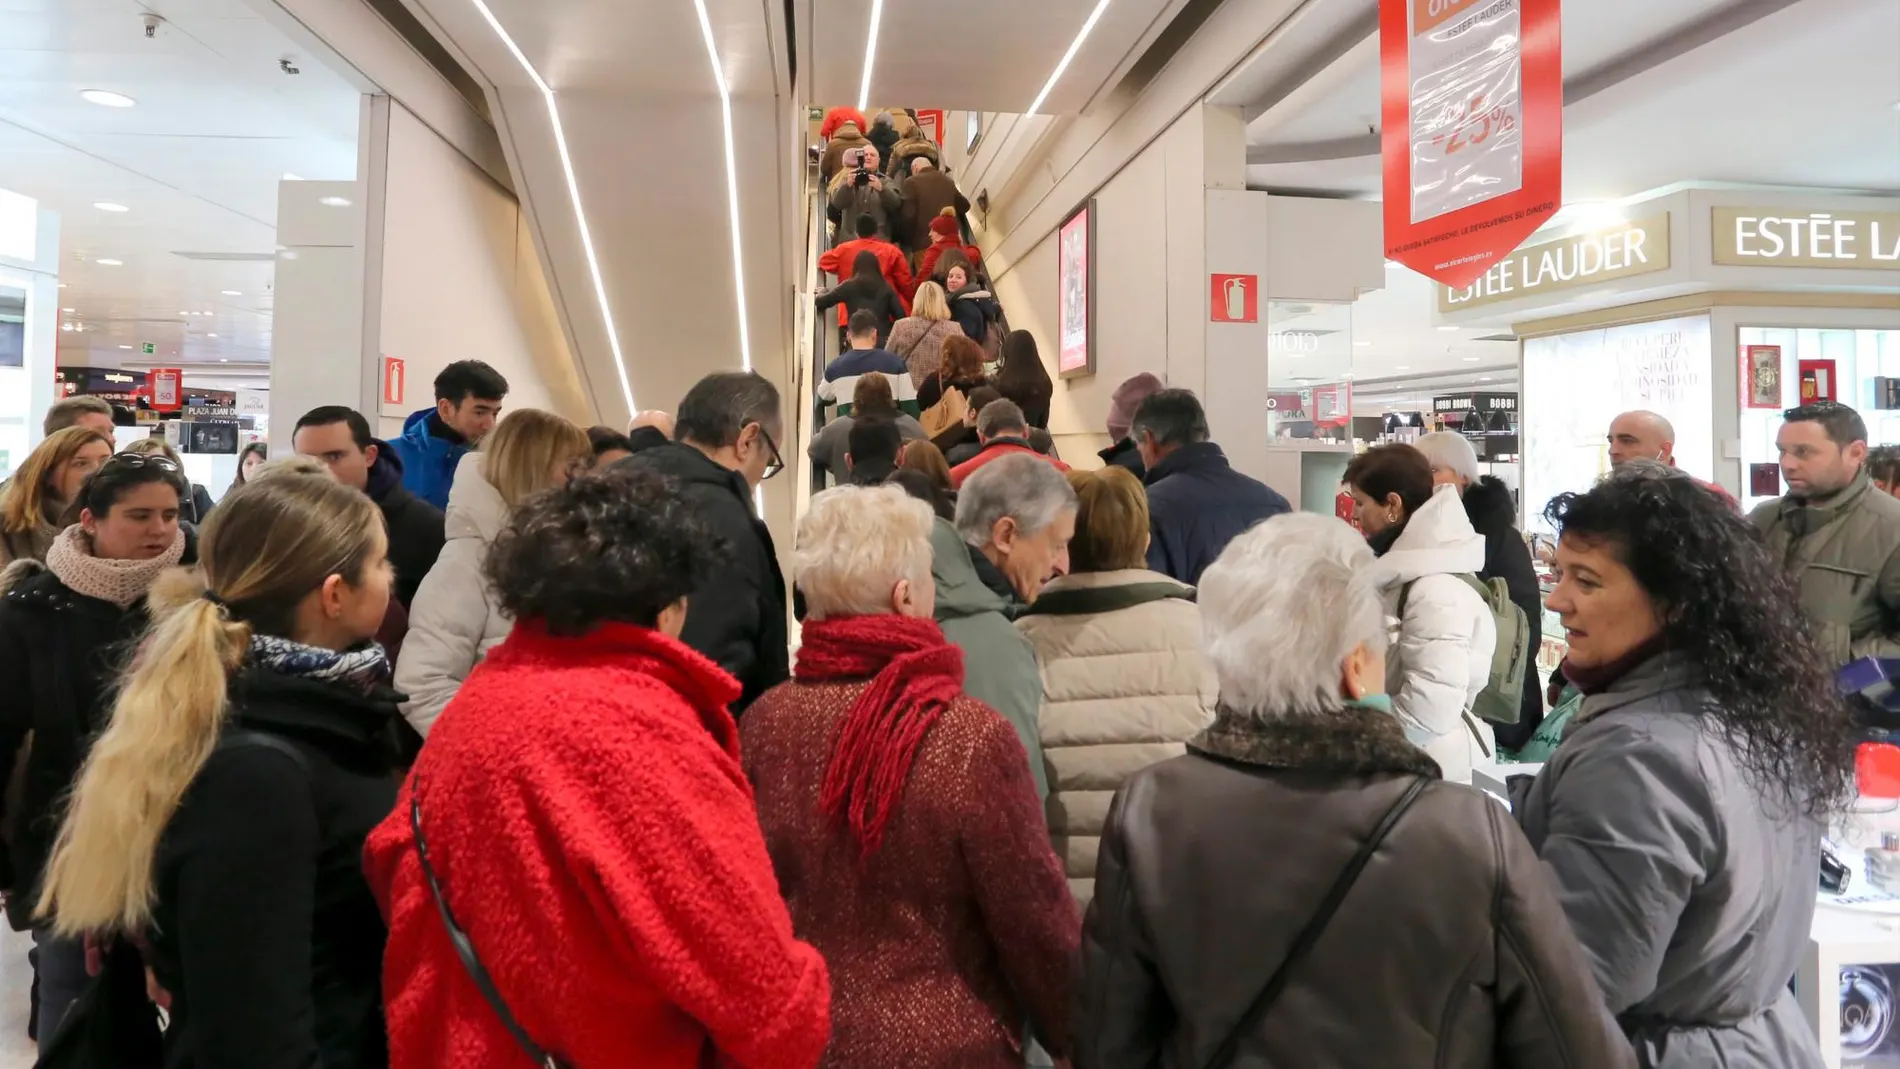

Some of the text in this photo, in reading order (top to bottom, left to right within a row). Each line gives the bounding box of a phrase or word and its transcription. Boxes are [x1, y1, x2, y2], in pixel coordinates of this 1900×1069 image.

[1470, 213, 1514, 234] DEVOLVEMOS
[1514, 210, 1525, 220] SU
[1522, 227, 1648, 289] LAUDER
[188, 407, 210, 416] PLAZA
[210, 407, 229, 416] JUAN
[1490, 398, 1515, 409] BOBBI
